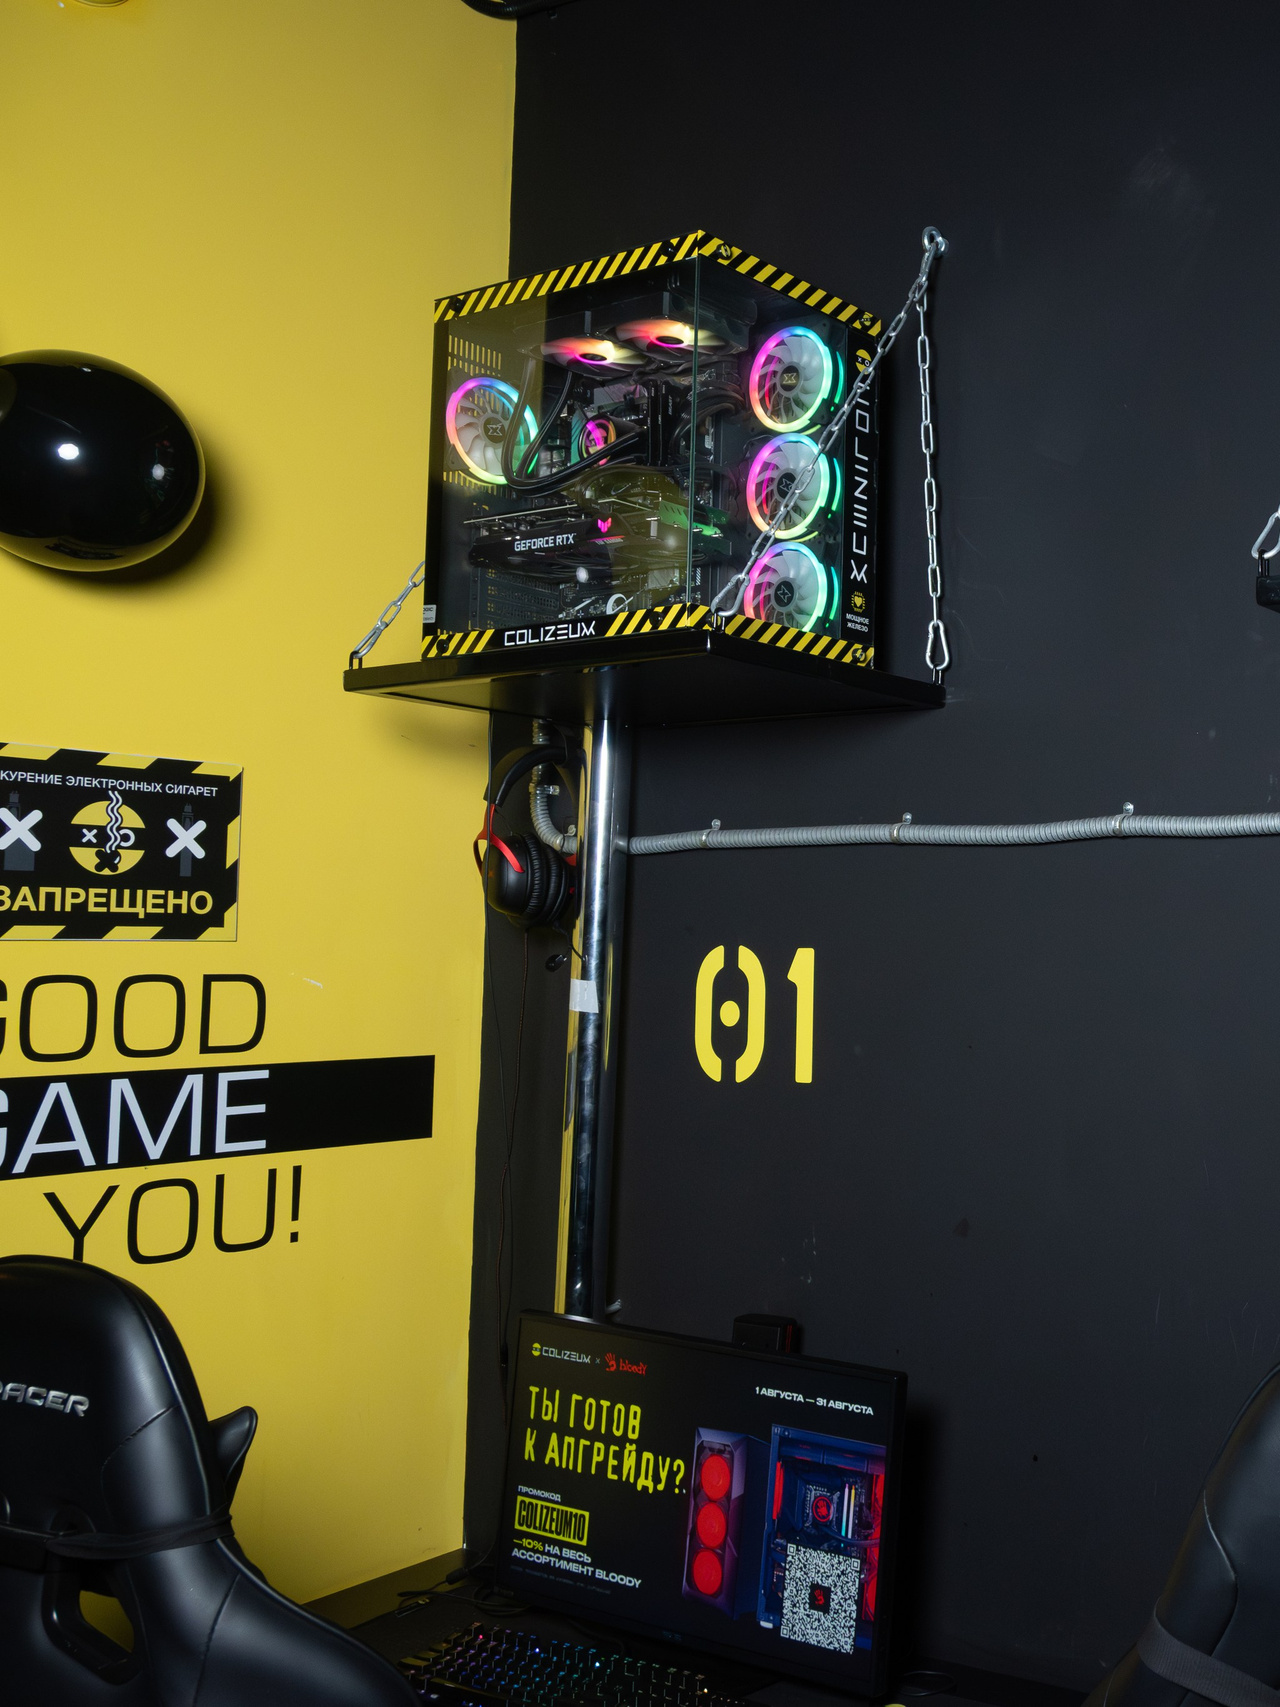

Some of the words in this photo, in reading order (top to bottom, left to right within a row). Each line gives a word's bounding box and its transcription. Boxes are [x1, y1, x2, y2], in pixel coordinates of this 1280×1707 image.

[514, 535, 554, 551] GEFORCE
[504, 620, 596, 646] COLIZEUM
[846, 613, 869, 624] МОЩНОЕ
[847, 622, 869, 632] ЖЕЛЕЗО
[0, 770, 62, 785] КУРЕНИЕ
[65, 775, 163, 793] ЭЛЕКТРОННЫХ
[165, 783, 218, 797] СИГАРЕТ
[0, 973, 267, 1063] OOD
[695, 944, 815, 1083] 01
[0, 1069, 270, 1174] AME
[43, 1165, 302, 1265] YOU!
[0, 1381, 89, 1417] ACER
[529, 1385, 560, 1423] ТЫ
[569, 1393, 641, 1440] ГОТОВ
[760, 1387, 804, 1403] АВГУСТА
[816, 1397, 827, 1407] 31
[828, 1400, 874, 1415] АВГУСТА
[524, 1427, 537, 1462] К
[544, 1432, 686, 1494] АПГРЕЙДУ?
[518, 1485, 561, 1502] ПРОМОКОД
[517, 1499, 587, 1542] COLIZEUM10
[511, 1547, 595, 1577] АССОРТИМЕНТ
[595, 1569, 642, 1588] BLOODY
[544, 1543, 561, 1556] НА
[562, 1547, 592, 1564] ВЕСЬ
